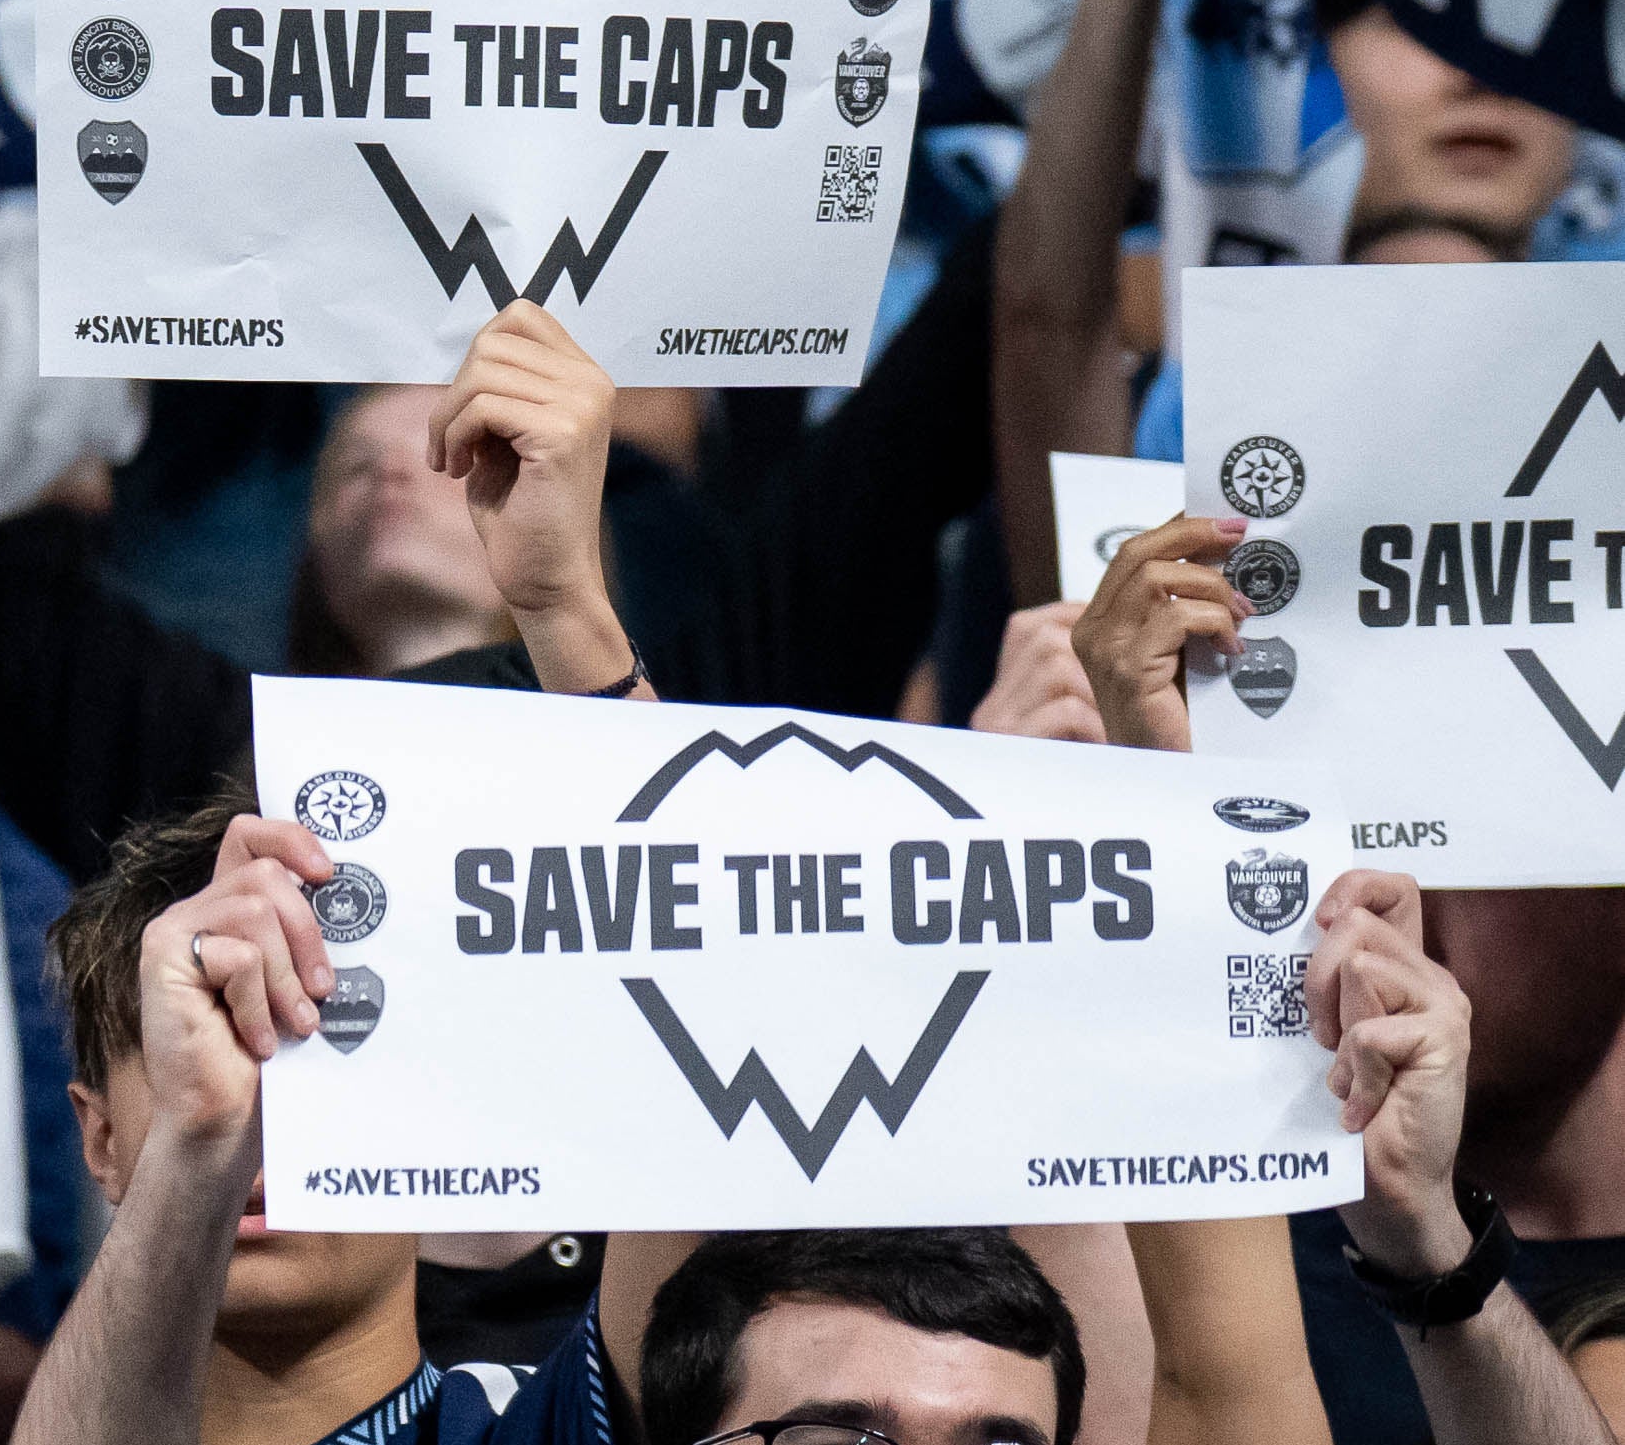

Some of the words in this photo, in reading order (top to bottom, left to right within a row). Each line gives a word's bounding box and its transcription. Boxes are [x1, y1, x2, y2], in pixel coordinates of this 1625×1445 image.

[74, 20, 111, 54] RAINCITY
[112, 20, 149, 54] BRIGADE
[76, 65, 135, 97] VANCOUVER
[134, 66, 148, 82] BC
[210, 6, 432, 120] SAVE
[453, 23, 577, 109] THE
[598, 14, 794, 130] CAPS
[839, 64, 886, 78] VANCOUVER
[73, 314, 285, 349] #SAVETHECAPS
[656, 325, 851, 358] SAVETHECAPS.COM
[1226, 438, 1299, 466] VANCOUVER
[1358, 517, 1576, 629] SAVE
[299, 771, 381, 797] VANCOUVER
[1230, 870, 1302, 886] VANCOUVER
[453, 843, 704, 955] SAVE
[724, 851, 865, 936] THE
[890, 837, 1155, 947] CAPS
[303, 1164, 542, 1199] #SAVETHECAPS
[1026, 1150, 1331, 1190] SAVETHECAPS.COM
